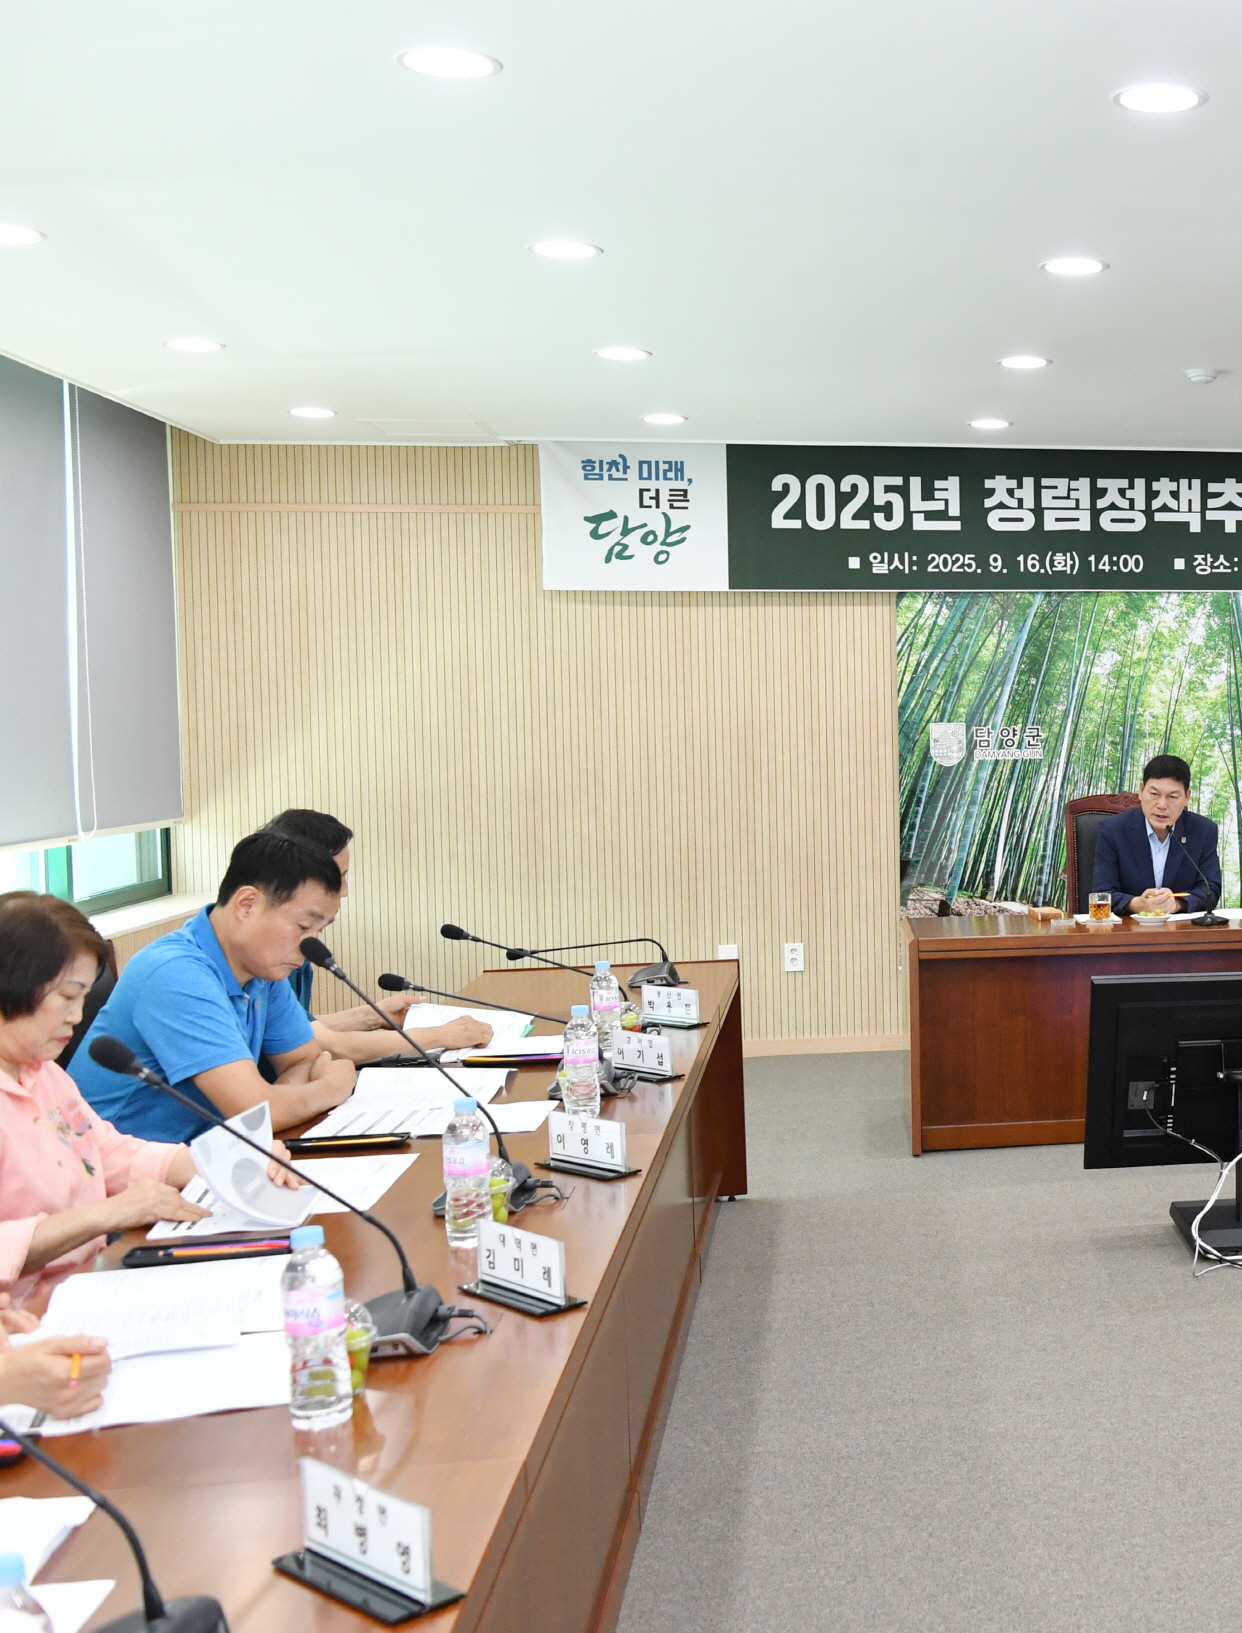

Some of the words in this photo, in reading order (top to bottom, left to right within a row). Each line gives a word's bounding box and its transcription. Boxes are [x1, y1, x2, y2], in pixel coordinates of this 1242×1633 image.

[580, 454, 630, 482] 힘찬
[638, 459, 693, 486] 미래,
[638, 489, 660, 509] 더
[668, 487, 691, 509] 큰
[770, 473, 962, 532] 2025년
[582, 509, 692, 566] 담양
[868, 551, 918, 574] 일시:
[927, 553, 982, 574] 2025.
[989, 553, 1008, 574] 9.
[1017, 552, 1080, 576] 16.(화)
[1088, 554, 1144, 573] 14:00
[1192, 553, 1239, 575] 장소:
[974, 726, 1043, 748] 담양군
[974, 750, 1020, 760] DAMYANG
[1022, 749, 1043, 759] GUN
